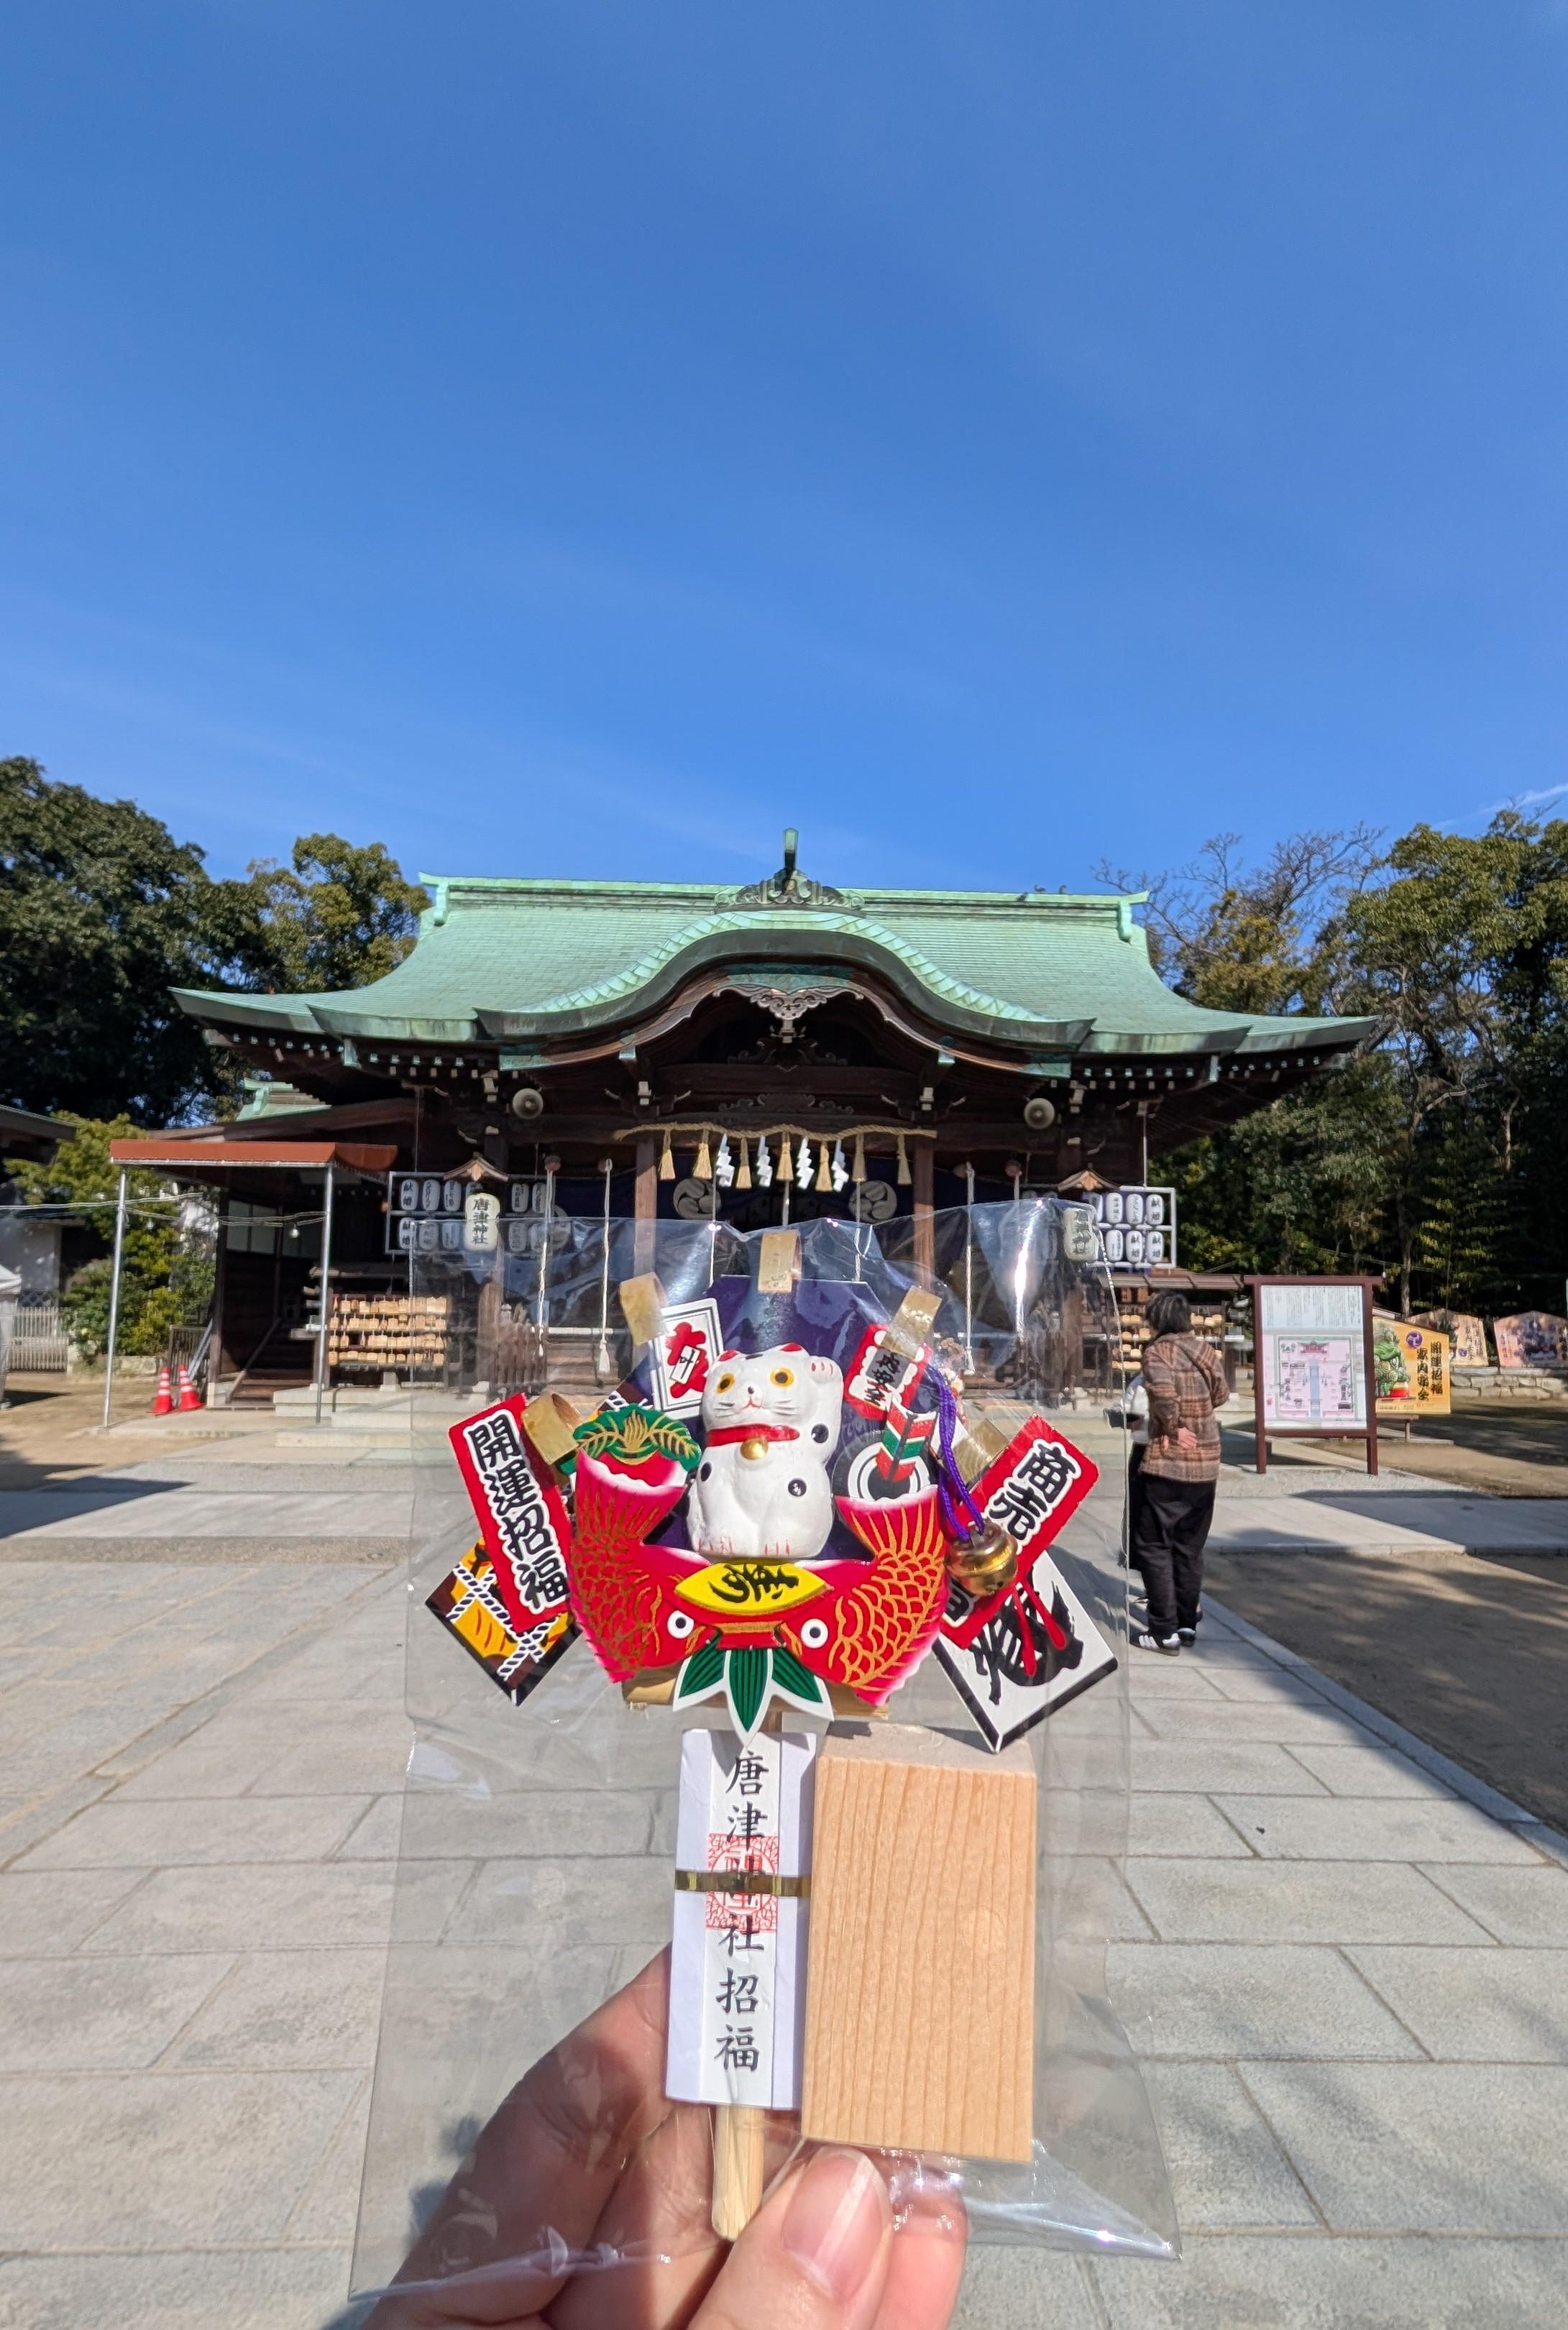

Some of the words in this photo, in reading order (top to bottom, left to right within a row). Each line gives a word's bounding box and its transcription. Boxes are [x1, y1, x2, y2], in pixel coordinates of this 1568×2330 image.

[472, 1197, 490, 1245] 唐津神社
[469, 1418, 571, 1610] 開運招福
